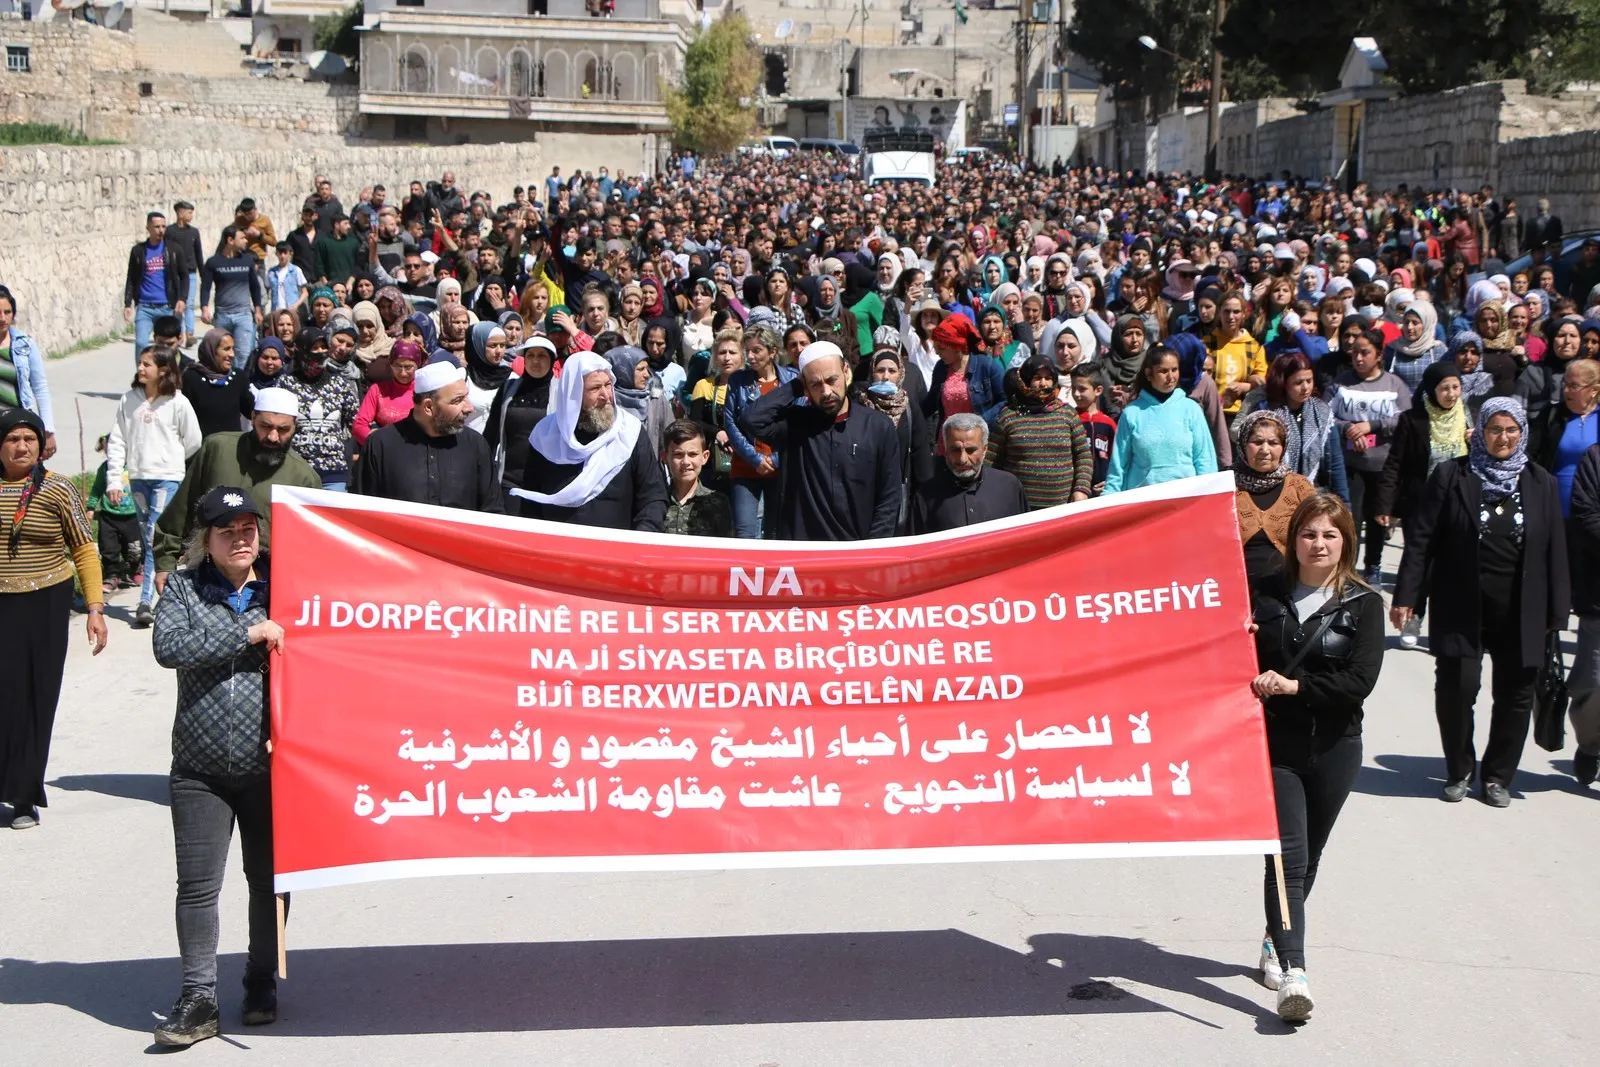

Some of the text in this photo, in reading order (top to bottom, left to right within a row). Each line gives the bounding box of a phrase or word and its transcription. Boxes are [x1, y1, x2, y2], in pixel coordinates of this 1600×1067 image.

[292, 431, 338, 448] adidas
[729, 564, 804, 596] NA
[294, 594, 321, 627] Jİ
[579, 609, 619, 634] RE
[627, 605, 654, 634] Lİ
[661, 610, 721, 634] SER
[724, 606, 829, 634] TAXÊN
[837, 597, 1037, 637] ŞÊXMEQSÛD
[1045, 592, 1067, 621] Û
[1075, 577, 1222, 625] EŞREFİYÊ
[530, 648, 578, 671] NA
[582, 644, 609, 671] Jİ
[617, 643, 767, 671] SİYASETA
[952, 640, 993, 664] RE
[581, 681, 812, 709] BERXWEDANA
[819, 675, 923, 705] GELÊN
[932, 674, 1024, 702] AZAD
[397, 710, 1152, 770] لا للحصار على أحياء الشيخ مقصود و الأشرفية
[607, 776, 728, 819] مقاومة
[738, 774, 843, 808] عاشت
[882, 768, 1017, 815] التجويع
[1024, 761, 1154, 807] لسياسة
[1168, 759, 1192, 796] لا
[353, 780, 447, 825] الحرة
[456, 776, 598, 823] الشعوب
